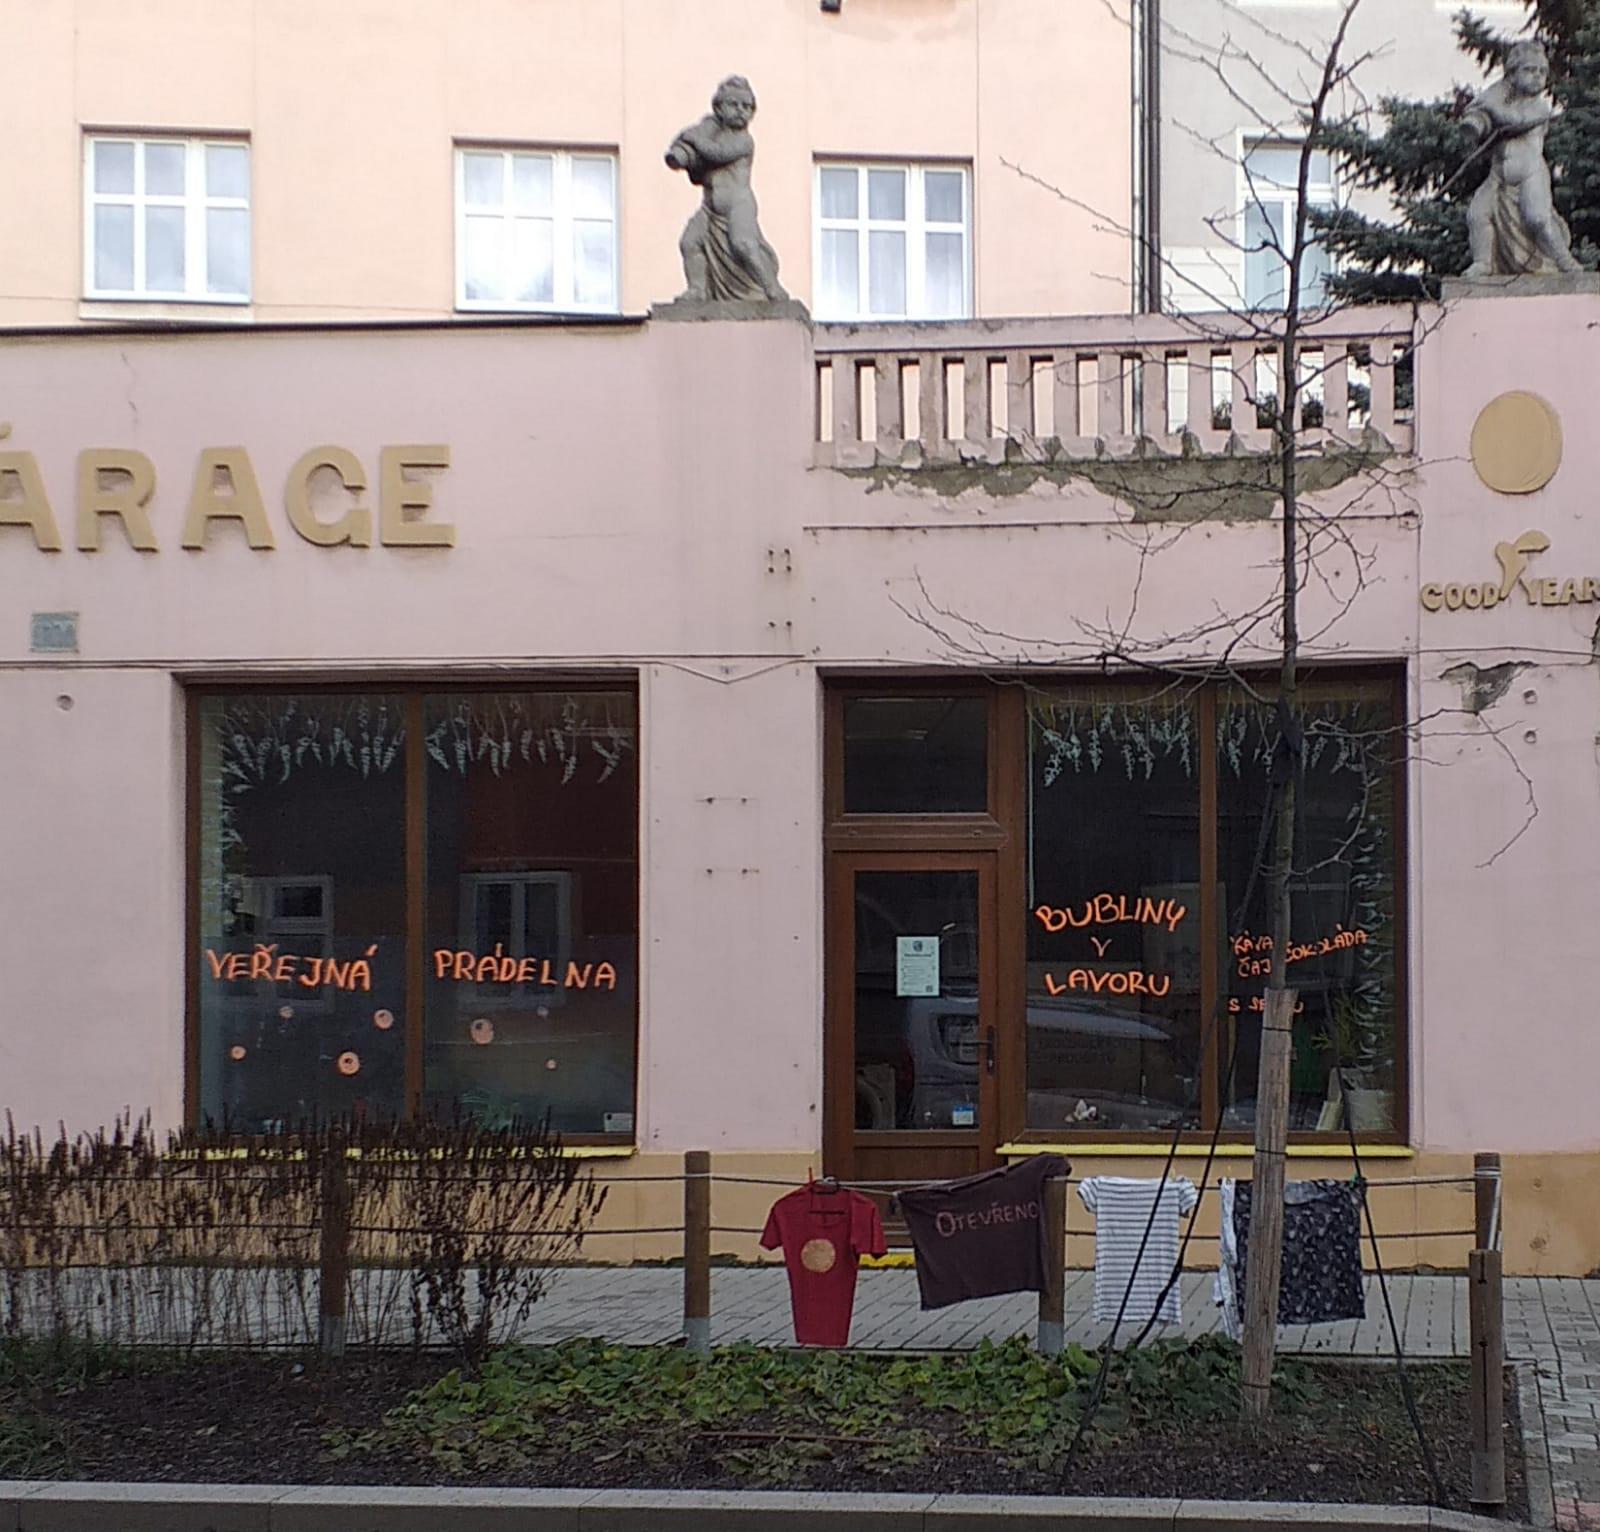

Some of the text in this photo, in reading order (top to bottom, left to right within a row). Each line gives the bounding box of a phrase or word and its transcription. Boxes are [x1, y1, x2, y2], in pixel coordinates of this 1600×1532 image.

[1035, 893, 1186, 932] BUBLINY
[206, 943, 616, 991] VEŘEJNÁ PRÁDELNA
[1044, 969, 1171, 998] LAVORU
